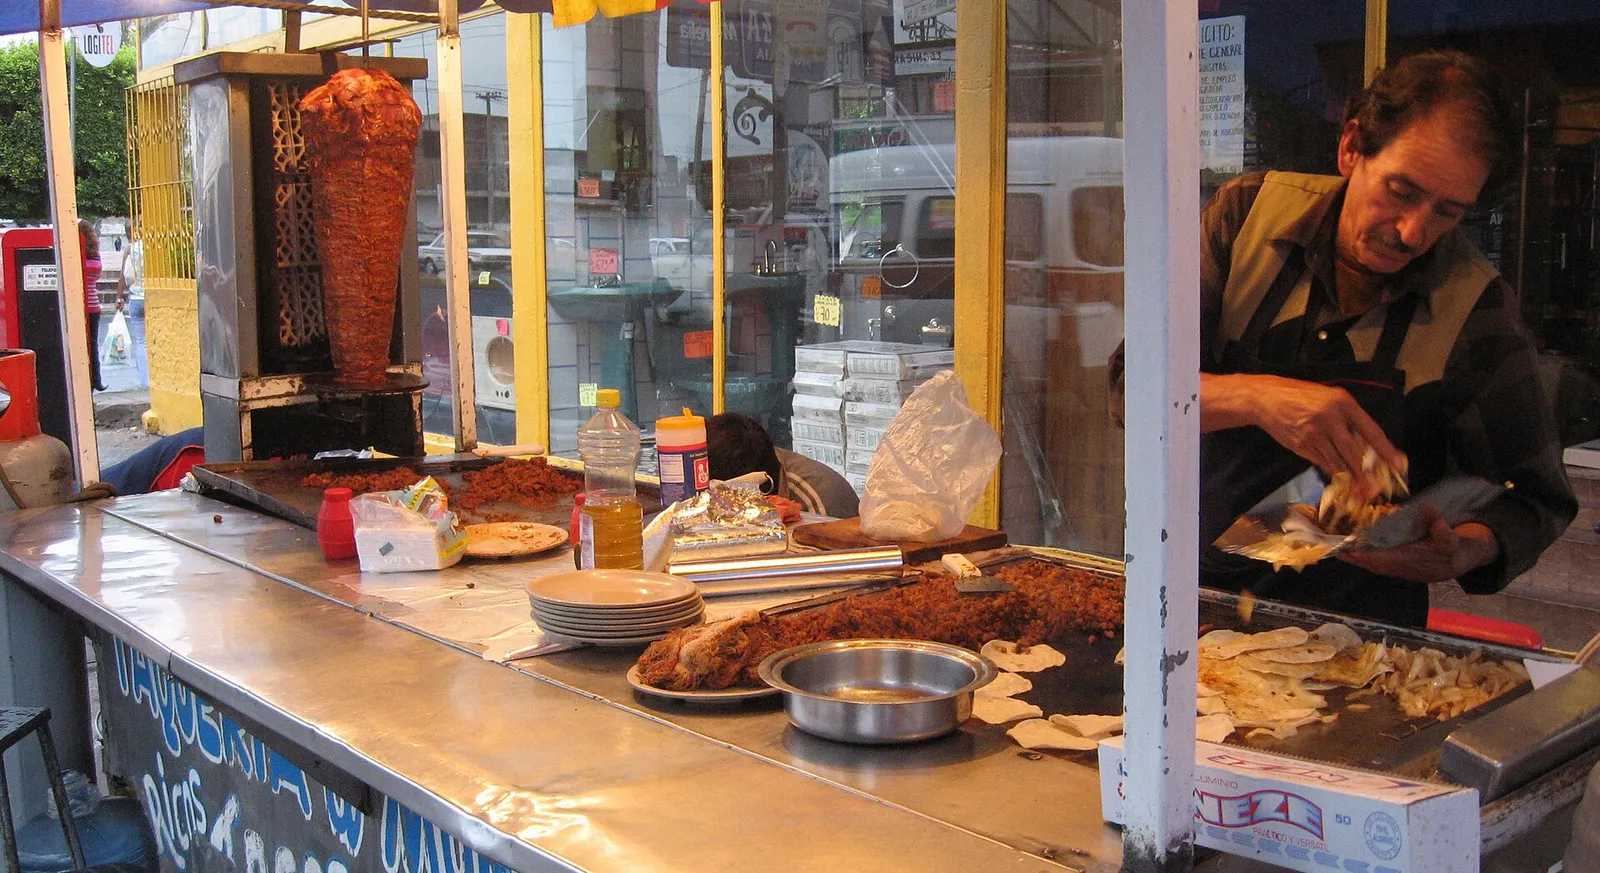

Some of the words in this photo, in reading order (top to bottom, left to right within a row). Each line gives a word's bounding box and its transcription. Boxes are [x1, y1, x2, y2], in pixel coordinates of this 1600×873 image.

[83, 34, 115, 55] LOGITEL
[1209, 43, 1244, 58] GENERAL
[1335, 813, 1351, 825] 50
